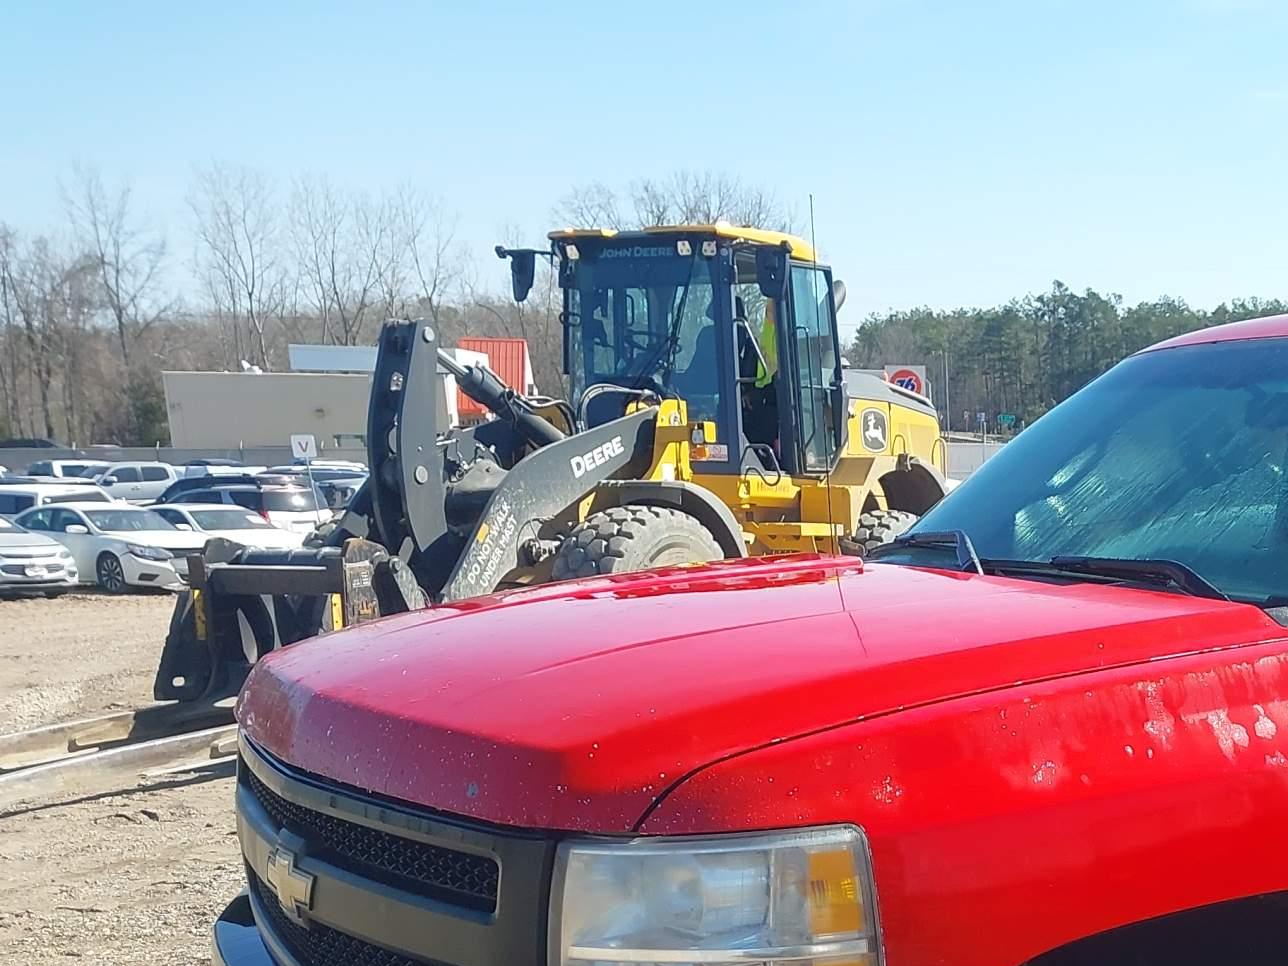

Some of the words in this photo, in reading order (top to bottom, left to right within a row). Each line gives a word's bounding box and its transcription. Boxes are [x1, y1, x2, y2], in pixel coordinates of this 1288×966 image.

[600, 247, 632, 258] JOHN
[633, 246, 674, 257] DEERE
[298, 441, 308, 453] V
[570, 436, 625, 479] DEERE
[467, 563, 480, 584] DO
[478, 536, 494, 562] NOT
[490, 502, 511, 536] WALK
[480, 546, 503, 586] UNDER
[499, 516, 517, 548] MAST
